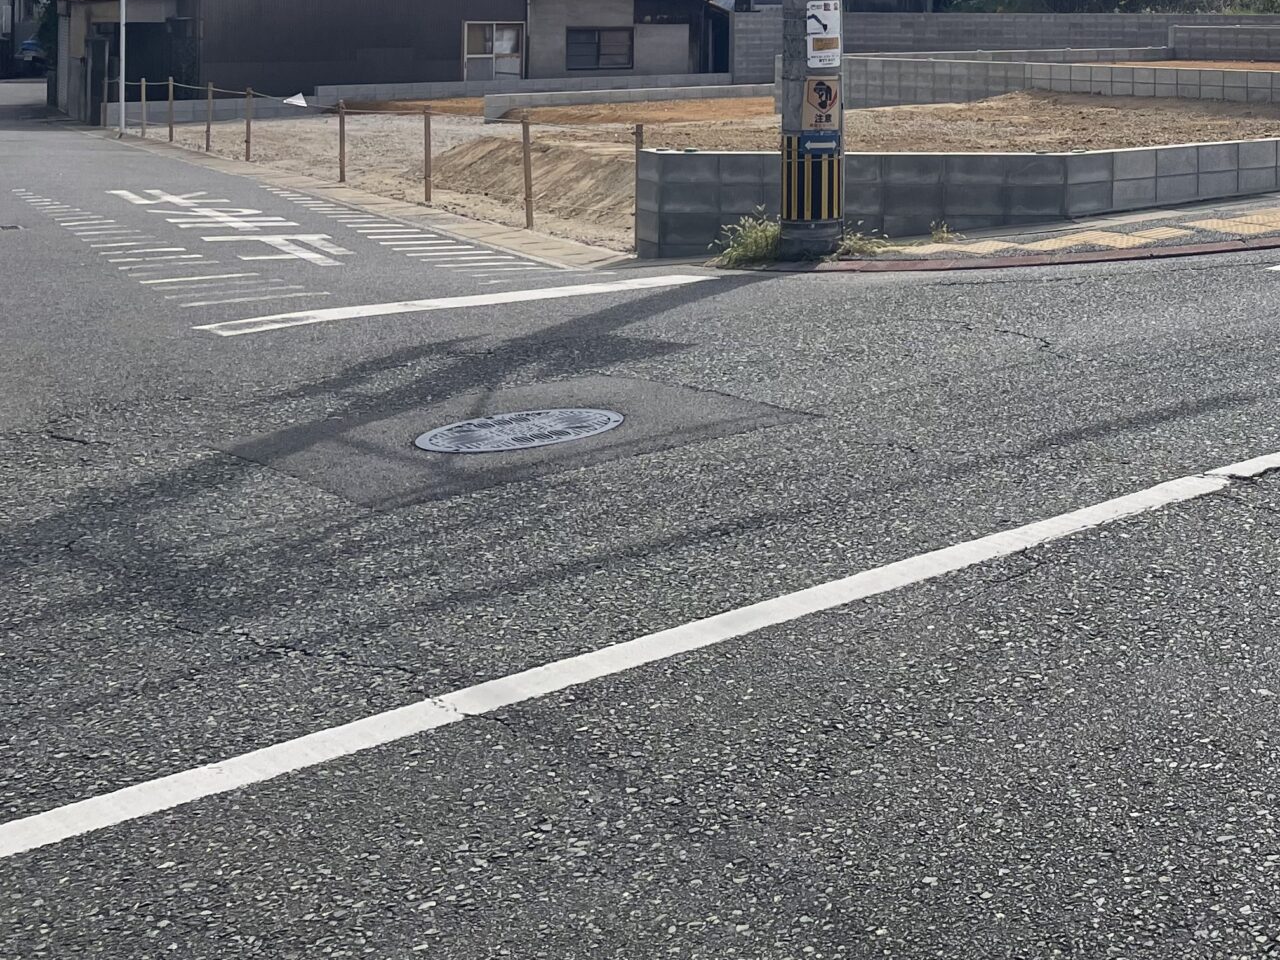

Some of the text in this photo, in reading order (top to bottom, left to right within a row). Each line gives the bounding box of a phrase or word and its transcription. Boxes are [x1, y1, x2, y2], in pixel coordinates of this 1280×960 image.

[814, 113, 832, 123] 注意
[104, 189, 357, 266] 止まれ
